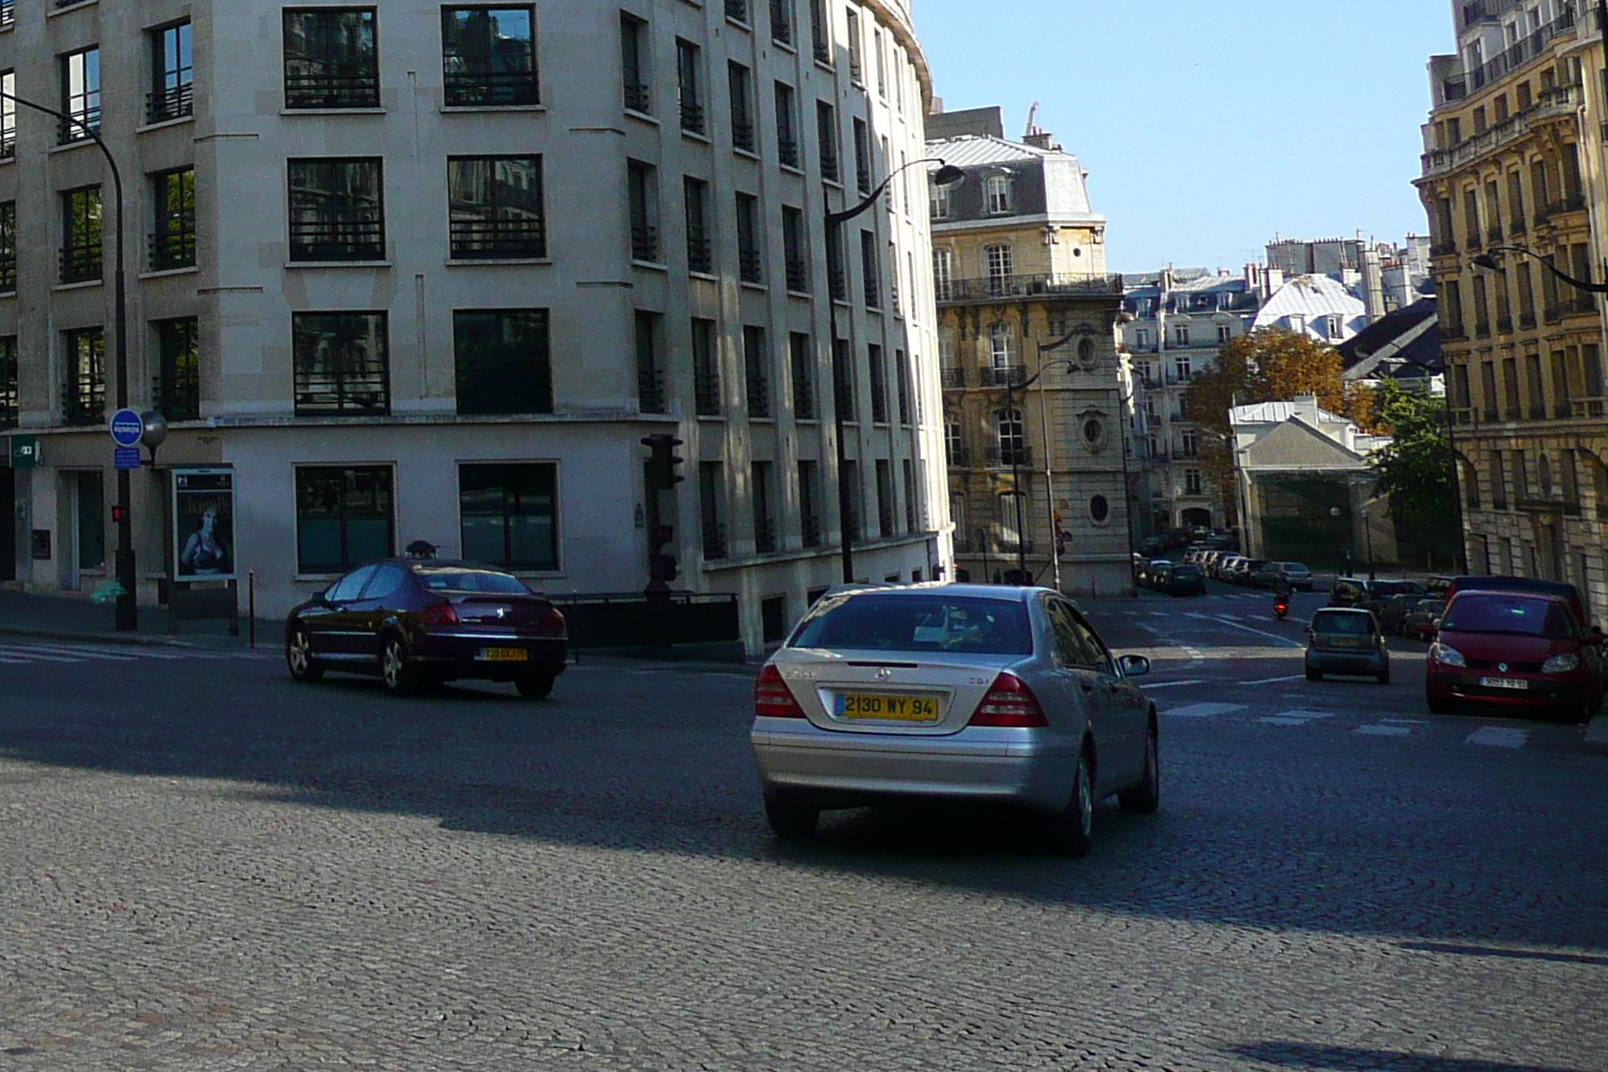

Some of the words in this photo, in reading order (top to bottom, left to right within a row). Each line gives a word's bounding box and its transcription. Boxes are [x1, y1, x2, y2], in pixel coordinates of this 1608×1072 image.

[845, 696, 881, 713] 2130
[886, 699, 908, 714] WY
[911, 700, 933, 715] 94
